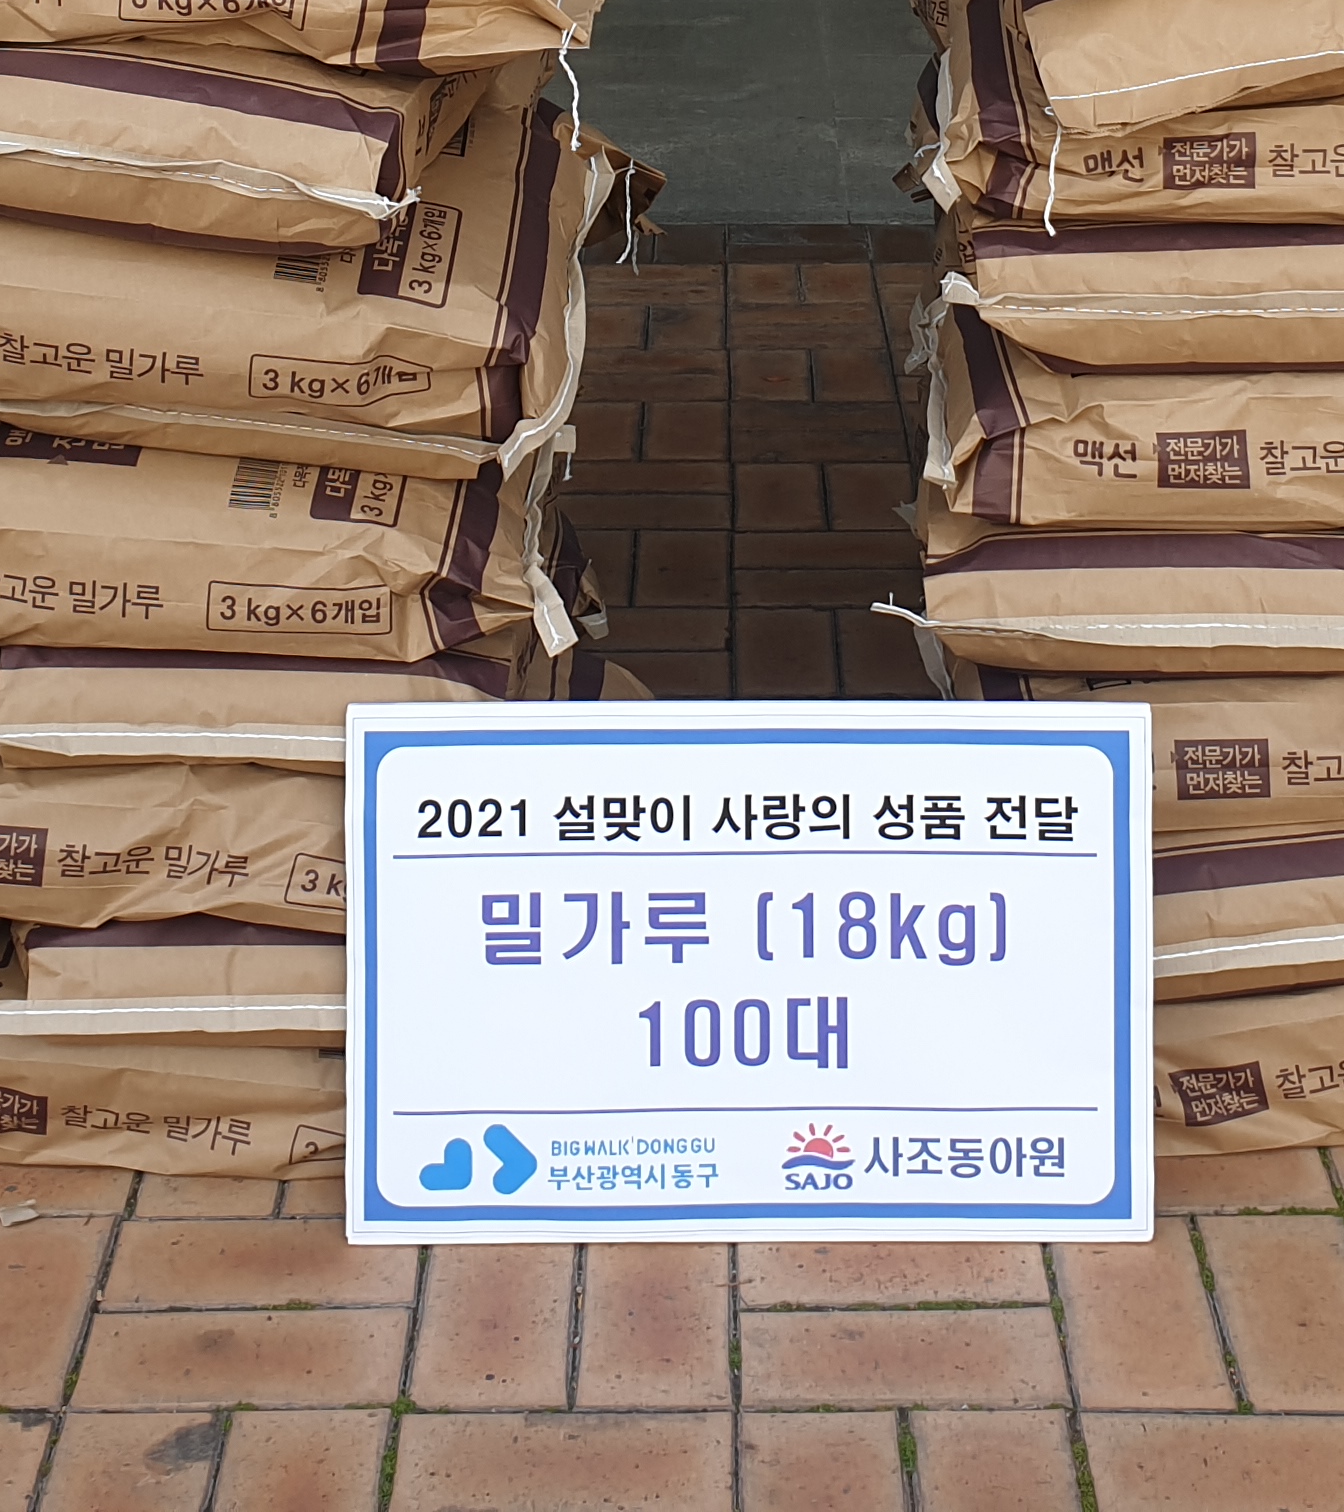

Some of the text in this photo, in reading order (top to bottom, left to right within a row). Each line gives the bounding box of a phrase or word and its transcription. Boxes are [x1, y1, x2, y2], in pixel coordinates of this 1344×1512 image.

[1082, 147, 1147, 183] 맥선
[1170, 139, 1250, 163] 전문가가
[1171, 161, 1248, 186] 먼저찾는
[104, 347, 206, 387] 밀가루
[1072, 439, 1139, 480] 맥선
[1165, 436, 1241, 460] 전문가가
[1167, 459, 1243, 485] 먼저찾는
[67, 580, 165, 622] 밀가루
[1182, 744, 1262, 770] 전문가가
[1185, 769, 1263, 796] 먼저찾는
[417, 792, 1079, 843] 2021 설맞이 사랑의 성품 전달
[57, 843, 250, 888] 찰고운 밀가루
[481, 890, 711, 966] 밀가루
[639, 994, 852, 1069] 100대
[1178, 1069, 1255, 1099] 전문가가
[1191, 1091, 1261, 1122] 먼저찾는
[59, 1103, 253, 1156] 찰고운 밀가루
[863, 1136, 1067, 1178] 사조동아원
[547, 1163, 719, 1191] 부산광역시 동구
[784, 1172, 854, 1190] SAJO
